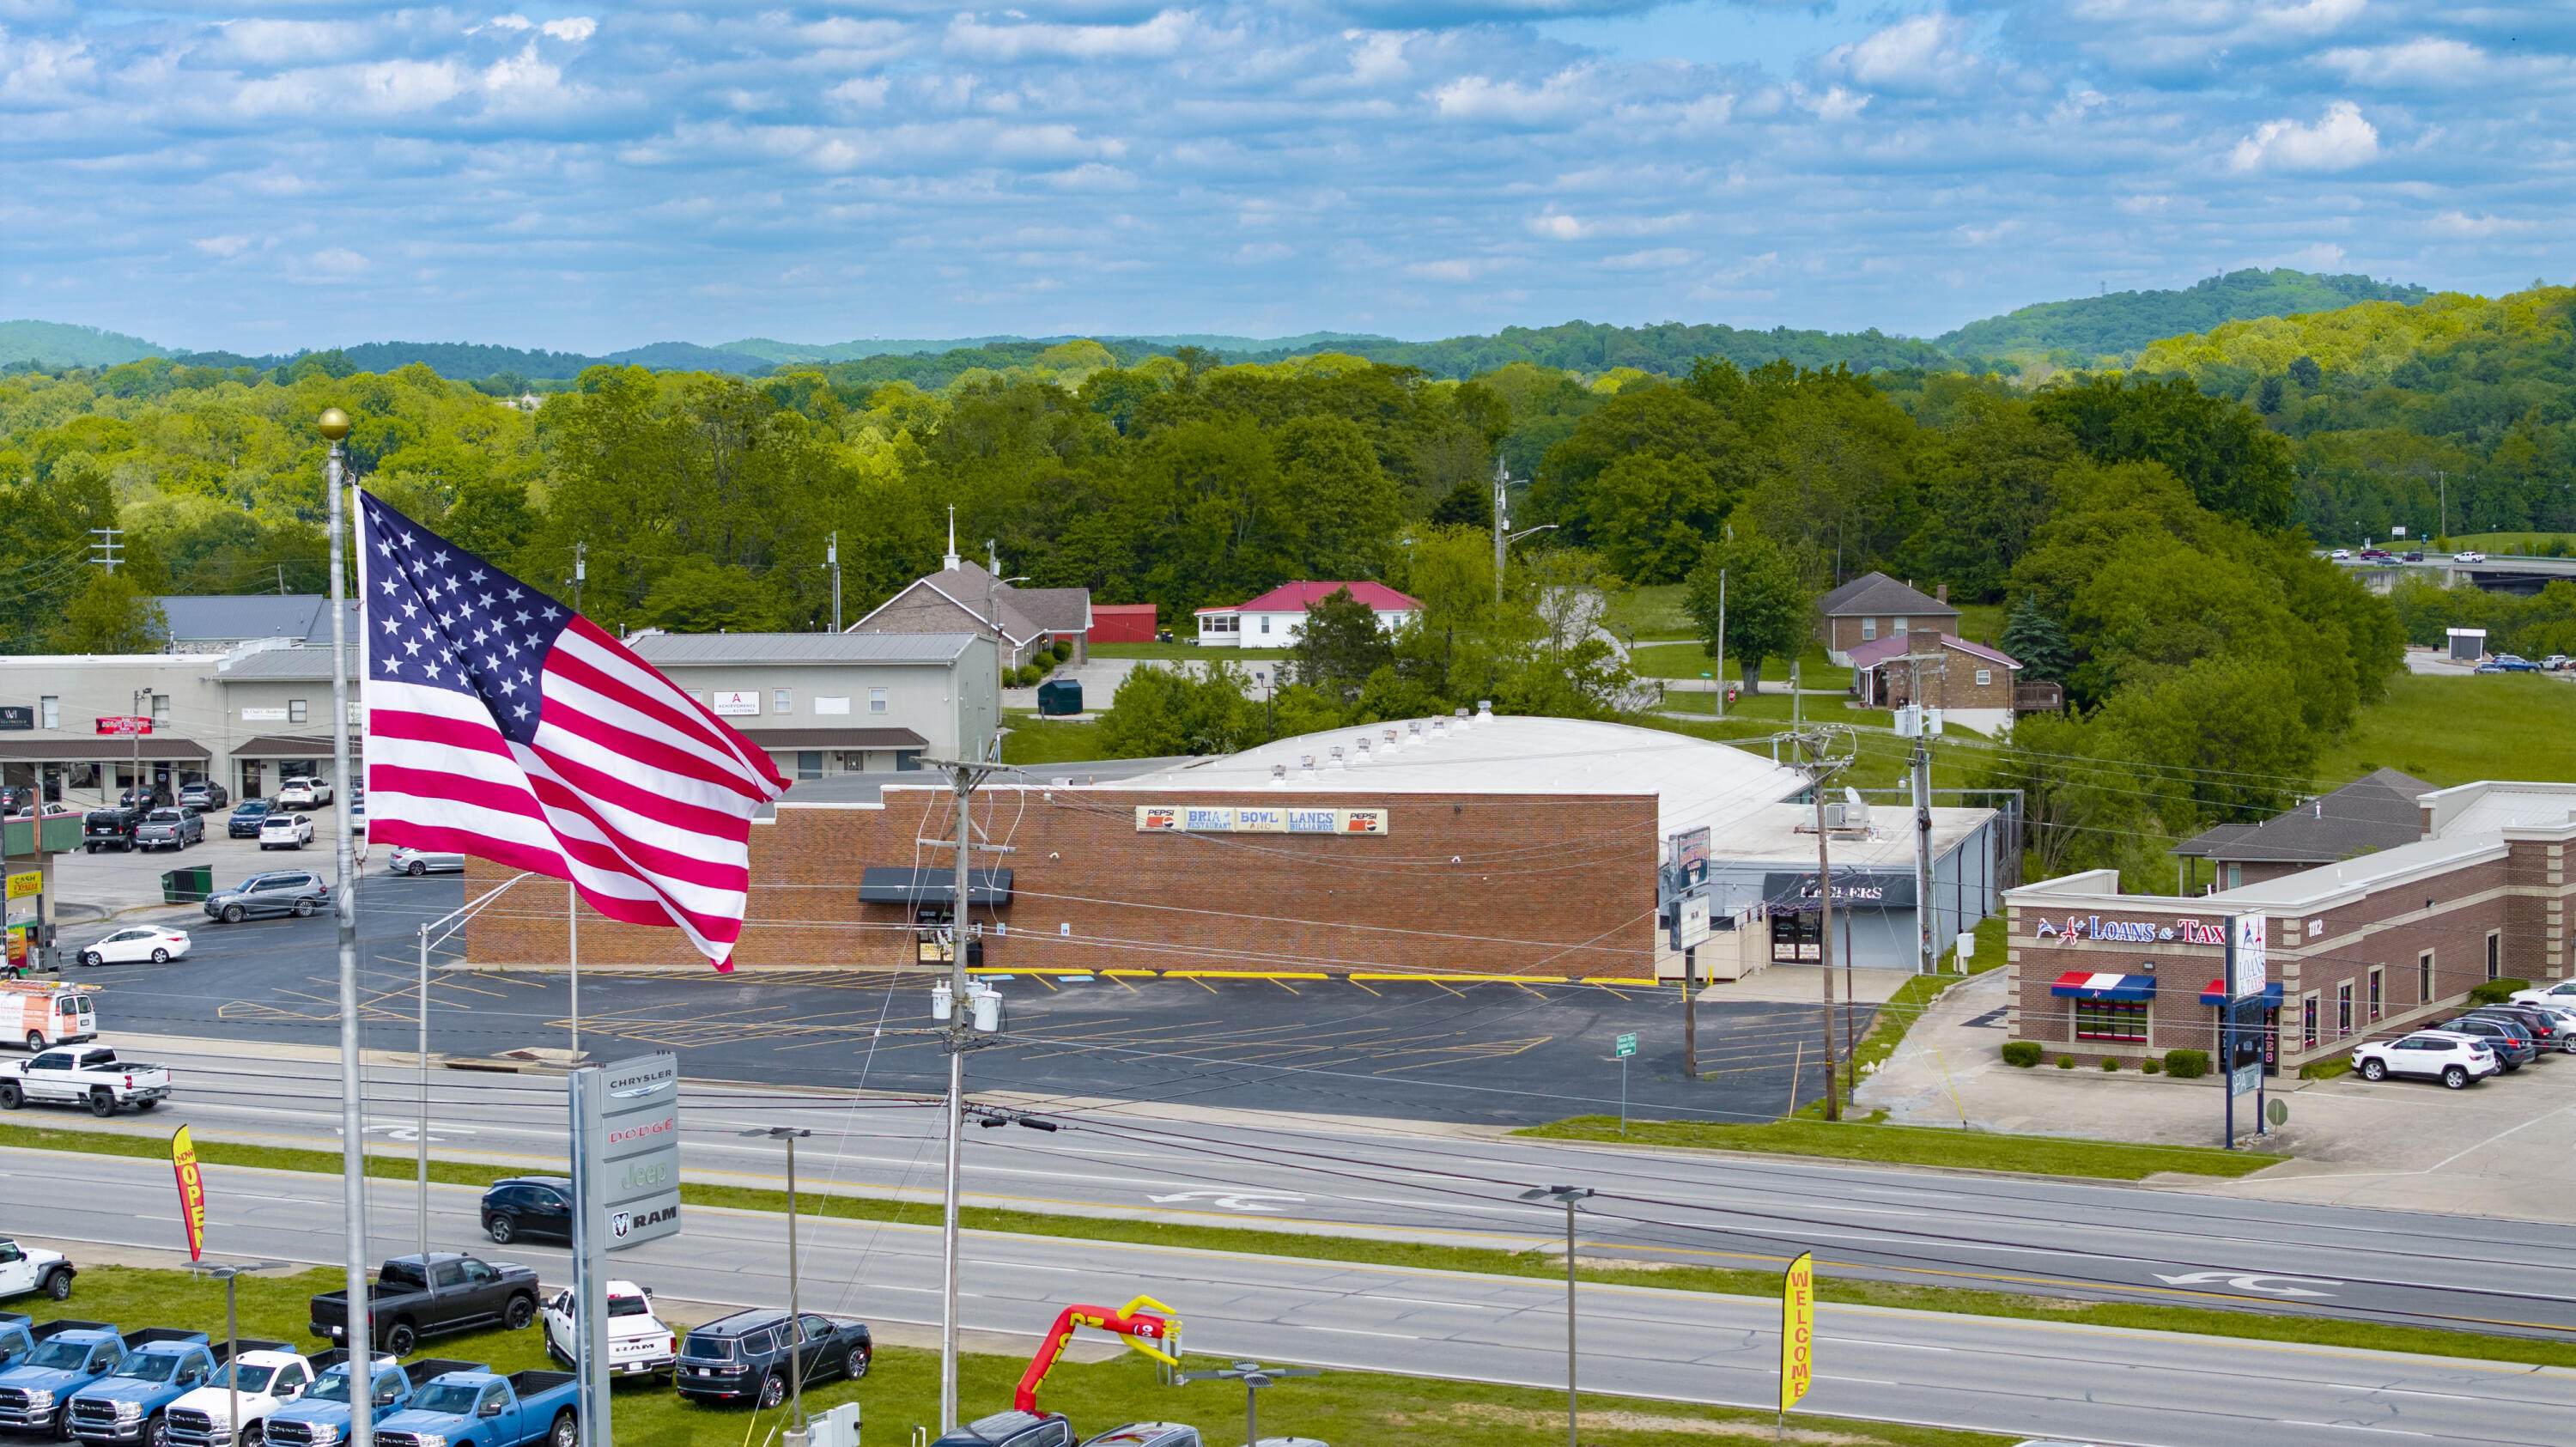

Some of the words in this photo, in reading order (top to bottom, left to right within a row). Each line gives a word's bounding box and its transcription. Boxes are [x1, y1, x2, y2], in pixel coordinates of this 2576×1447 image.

[1241, 812, 1279, 823] BOWL
[1290, 812, 1334, 824] LANES
[1290, 823, 1334, 831] BILLIARDS
[15, 874, 36, 885] CASH
[2088, 915, 2156, 943] LOANS
[2159, 927, 2175, 940] &
[2239, 954, 2265, 981] LOANS
[2245, 975, 2265, 994] TAXES
[609, 1068, 672, 1090] CHRYSLER
[609, 1117, 675, 1144] DODGE
[176, 1149, 193, 1164] NOW
[621, 1162, 668, 1191] Jeep
[181, 1164, 204, 1249] OPEN
[633, 1206, 677, 1229] RAM
[1790, 1270, 1809, 1398] WELCOME
[615, 1343, 654, 1353] RAM
